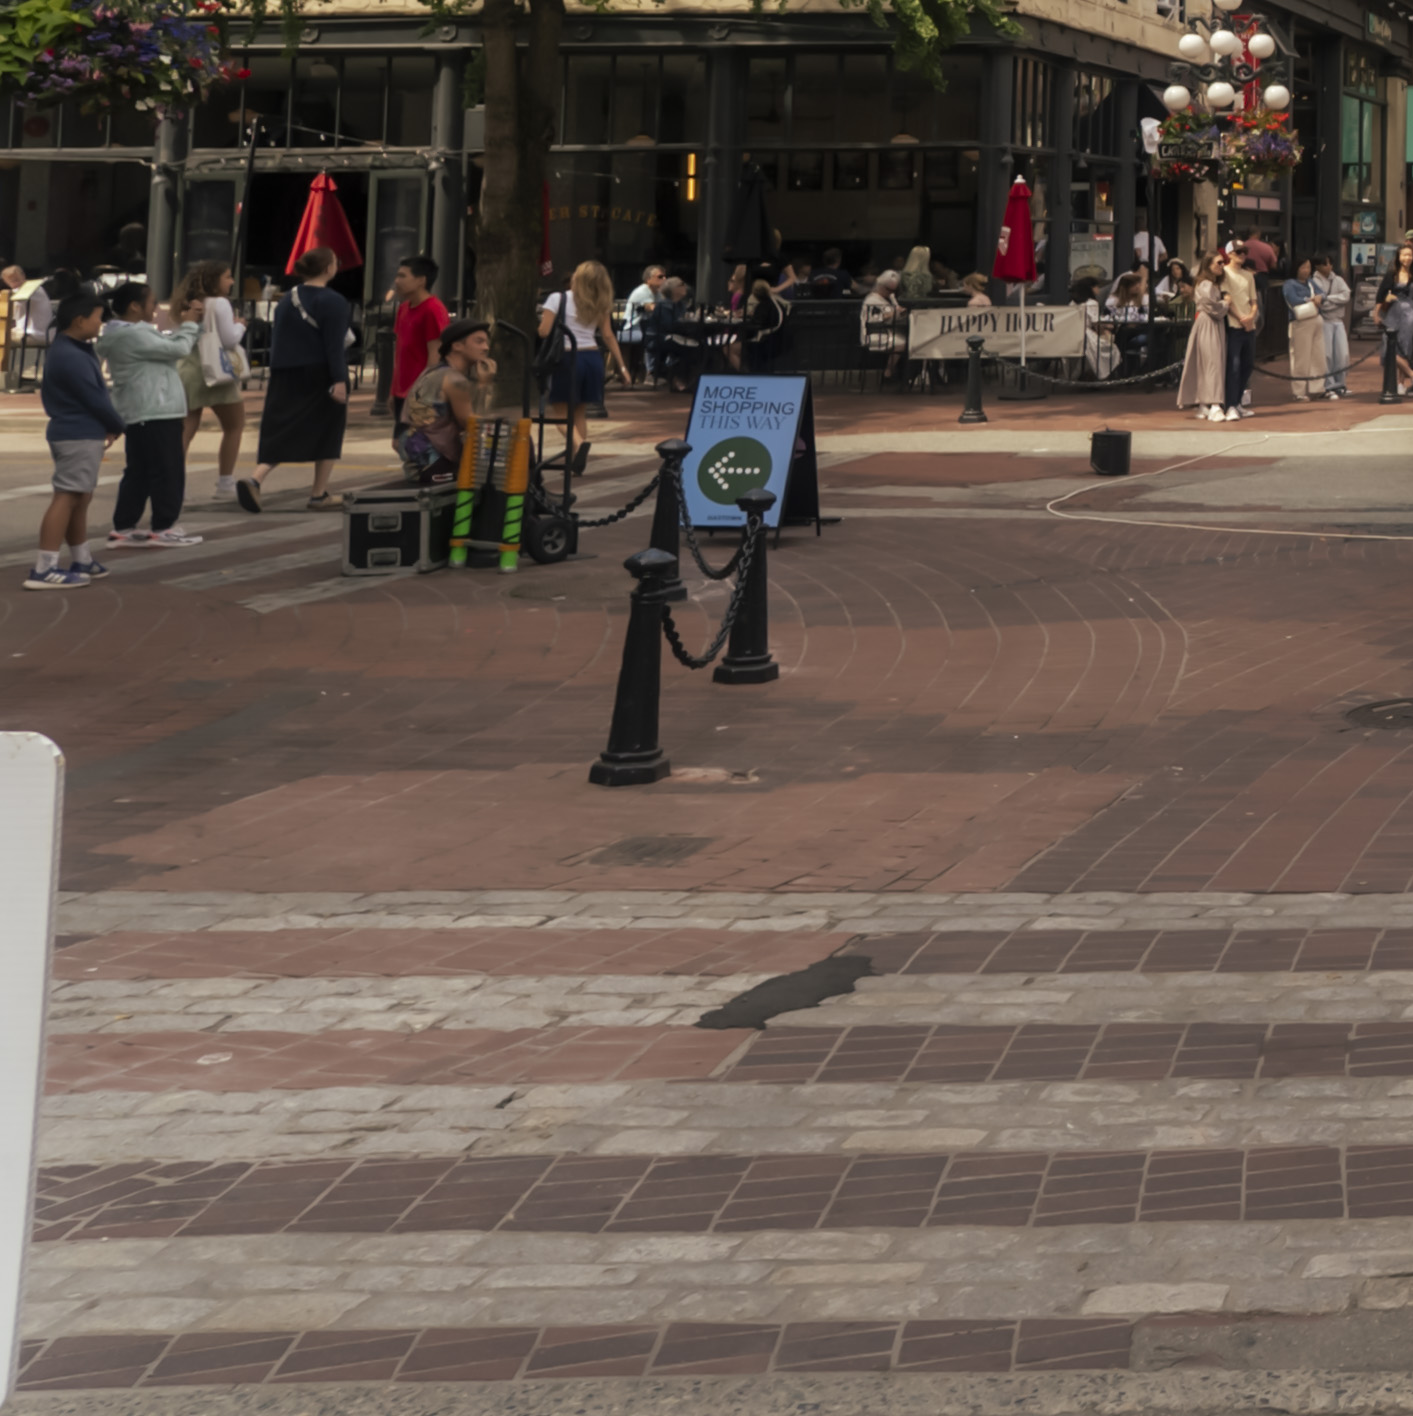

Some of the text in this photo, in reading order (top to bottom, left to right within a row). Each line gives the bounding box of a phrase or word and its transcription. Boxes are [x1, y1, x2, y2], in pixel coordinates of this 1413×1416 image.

[940, 312, 1055, 334] HAPPY HOUR
[703, 385, 758, 400] MORE
[700, 400, 795, 415] SHOPPING
[699, 415, 787, 430] THIS WAY
